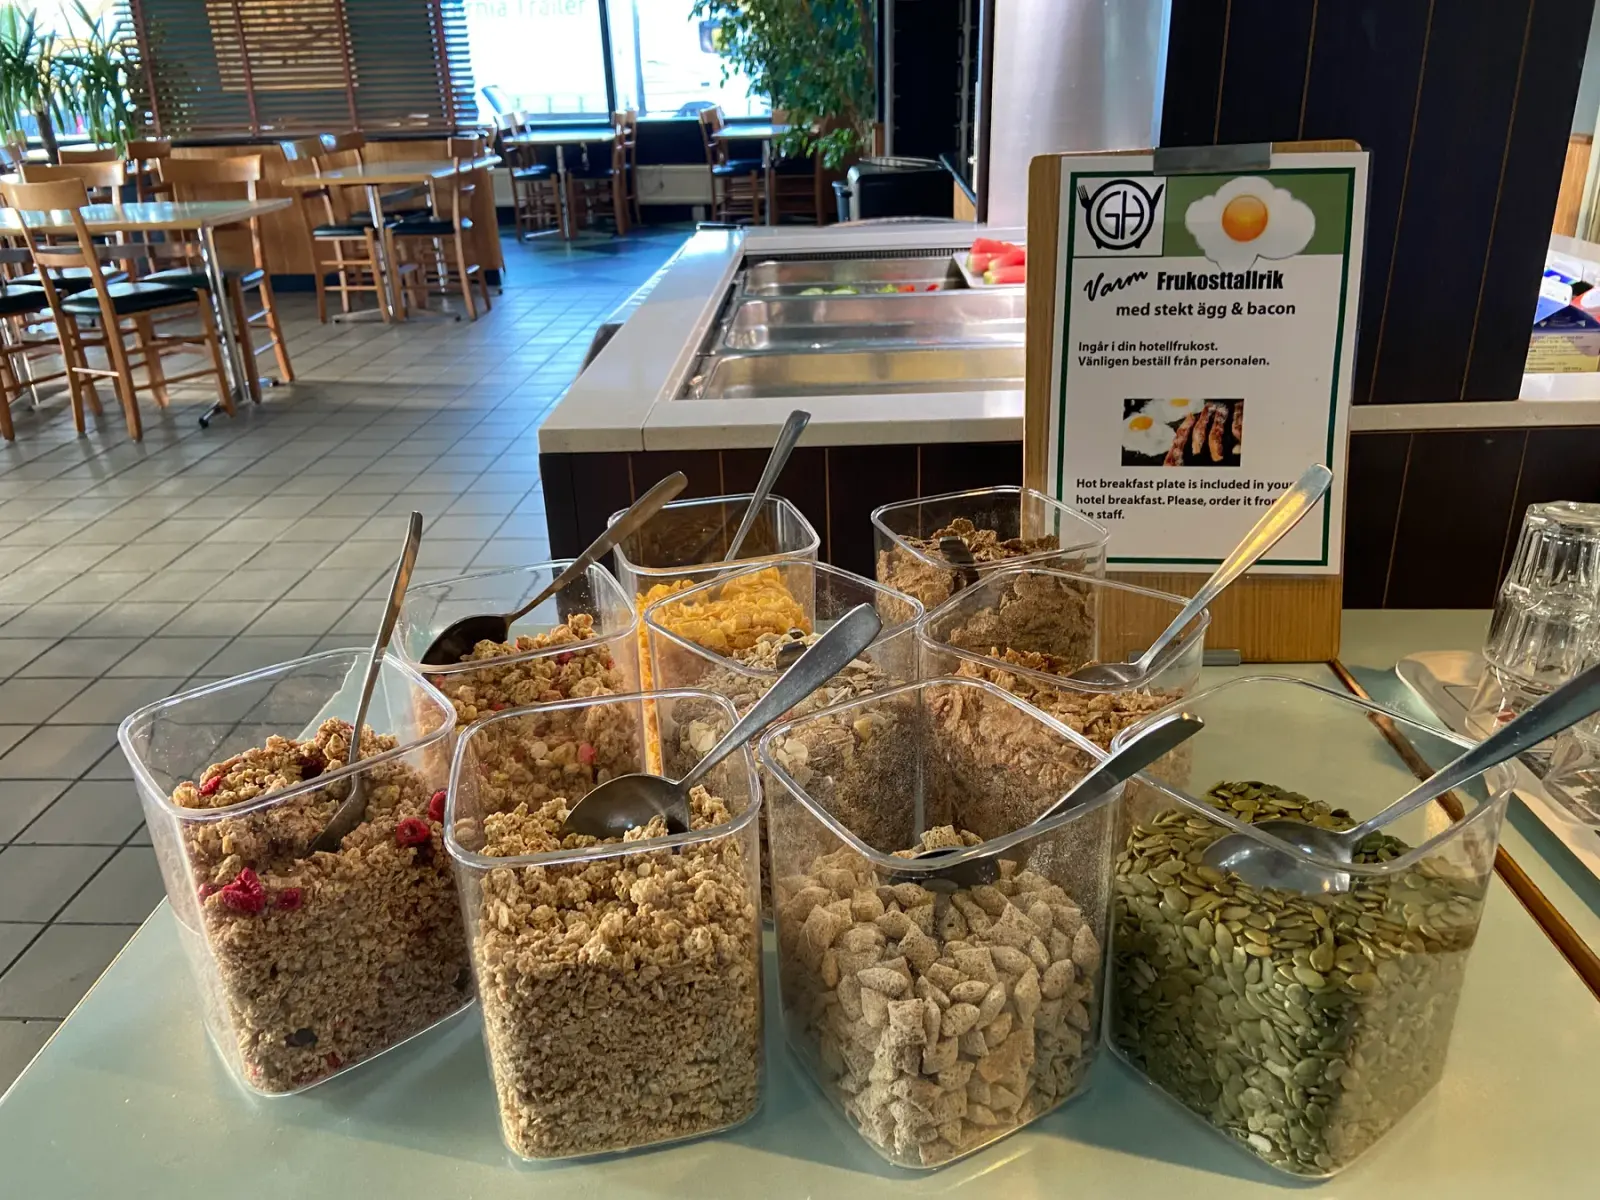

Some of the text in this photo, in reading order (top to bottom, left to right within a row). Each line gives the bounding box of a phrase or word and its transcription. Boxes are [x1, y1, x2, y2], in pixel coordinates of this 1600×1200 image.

[1084, 270, 1283, 301] Varm Frukosttallrik
[1115, 301, 1296, 320] med stekt ägg & bacon
[1078, 340, 1110, 355] Ingår
[1117, 340, 1137, 352] din
[1138, 340, 1218, 352] hotellfrukost.
[1077, 355, 1270, 369] Vänligen beställ från personalen.
[1076, 478, 1097, 489] Hot
[1099, 478, 1154, 489] breakfast
[1156, 478, 1186, 491] plate
[1188, 479, 1198, 489] is
[1199, 478, 1251, 490] included
[1252, 479, 1265, 490] in
[1075, 494, 1106, 505] hotel
[1107, 494, 1166, 505] breakfast.
[1167, 495, 1207, 507] Please,
[1208, 495, 1241, 506] order
[1243, 495, 1252, 506] it
[1096, 509, 1125, 520] staff.
